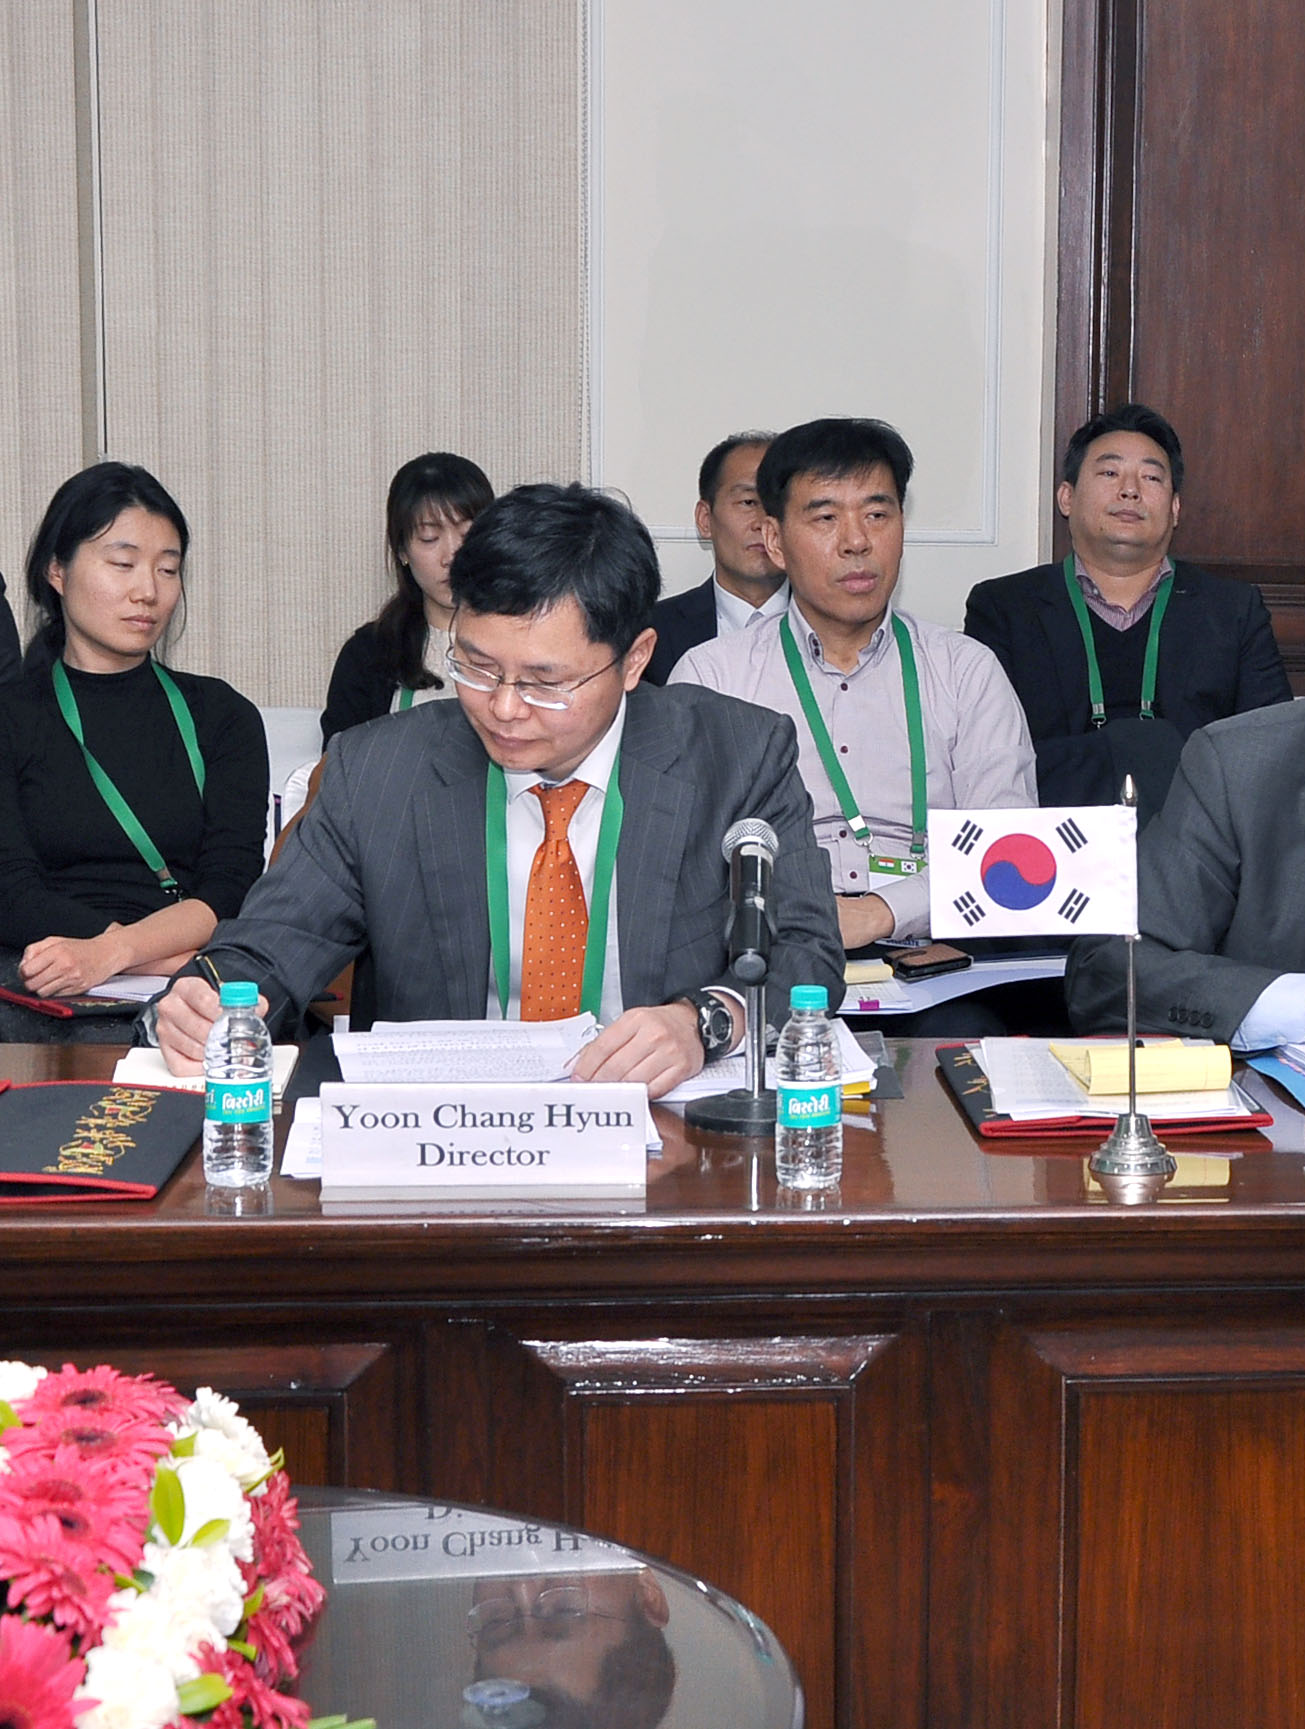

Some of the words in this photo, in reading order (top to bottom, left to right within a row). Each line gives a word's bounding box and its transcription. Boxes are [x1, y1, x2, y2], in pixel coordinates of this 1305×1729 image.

[332, 1104, 421, 1129] Yoon
[433, 1104, 535, 1133] Chang
[545, 1103, 634, 1133] Hyun
[417, 1142, 550, 1167] Director
